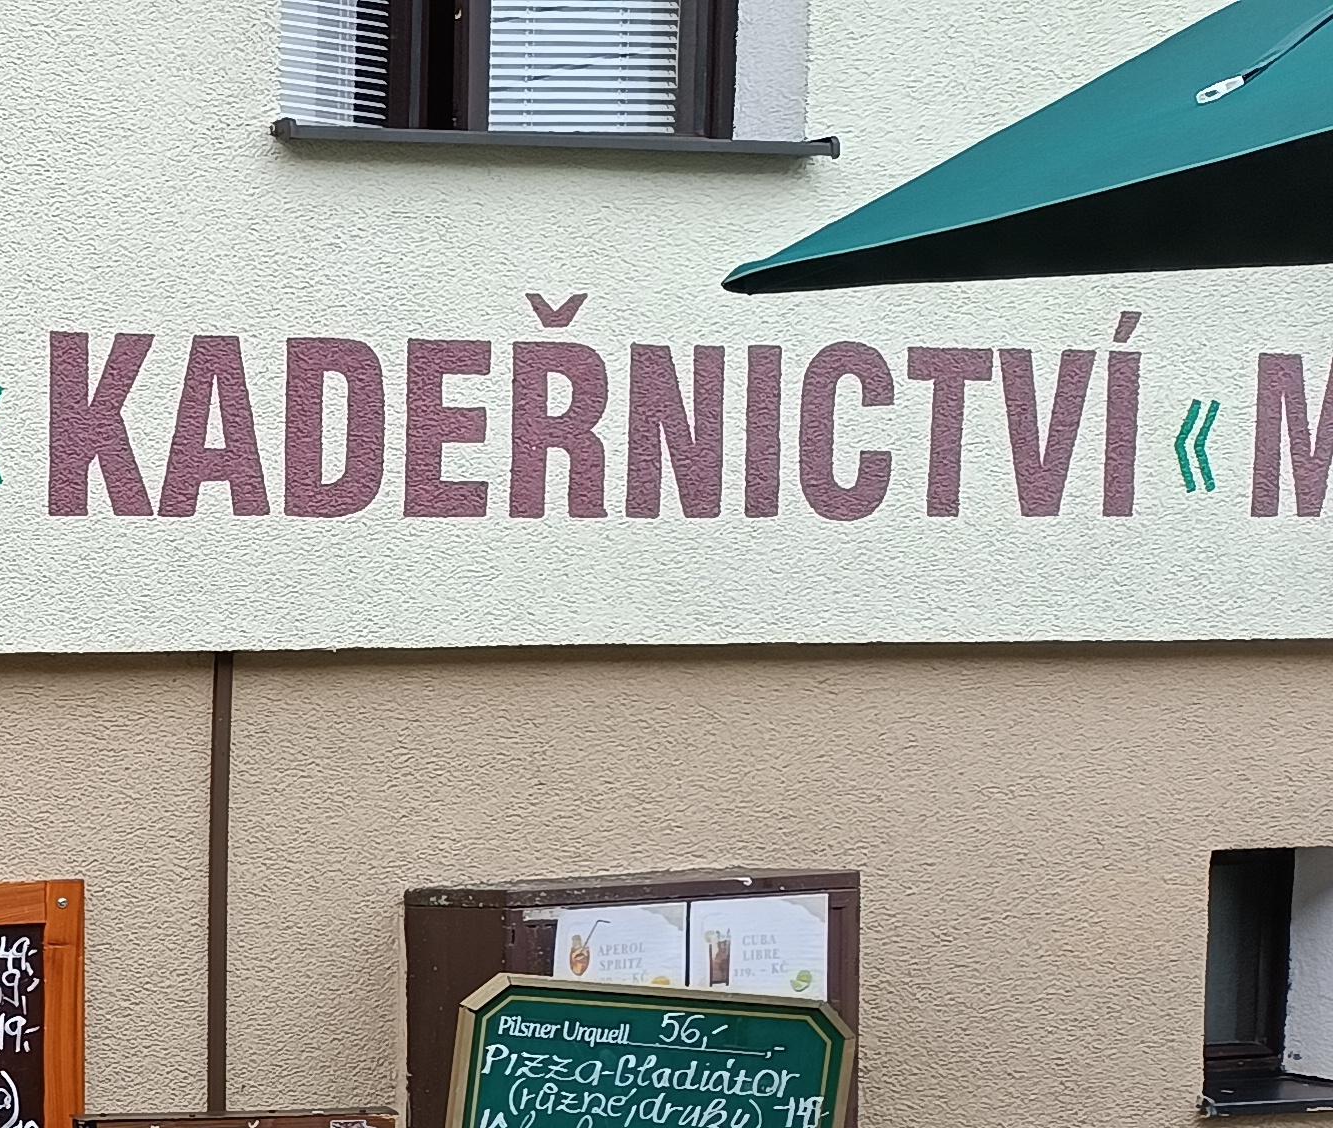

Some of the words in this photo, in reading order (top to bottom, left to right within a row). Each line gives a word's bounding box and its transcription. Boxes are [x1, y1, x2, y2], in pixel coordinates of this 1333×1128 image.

[47, 293, 1142, 522] KADEŘNICTVÍ
[741, 933, 778, 947] CUBA
[597, 942, 646, 957] APEROL
[742, 948, 781, 961] LIBRE
[599, 957, 644, 972] SPRITZ
[498, 1014, 561, 1041] Pilsner
[562, 1020, 630, 1048] Urquell
